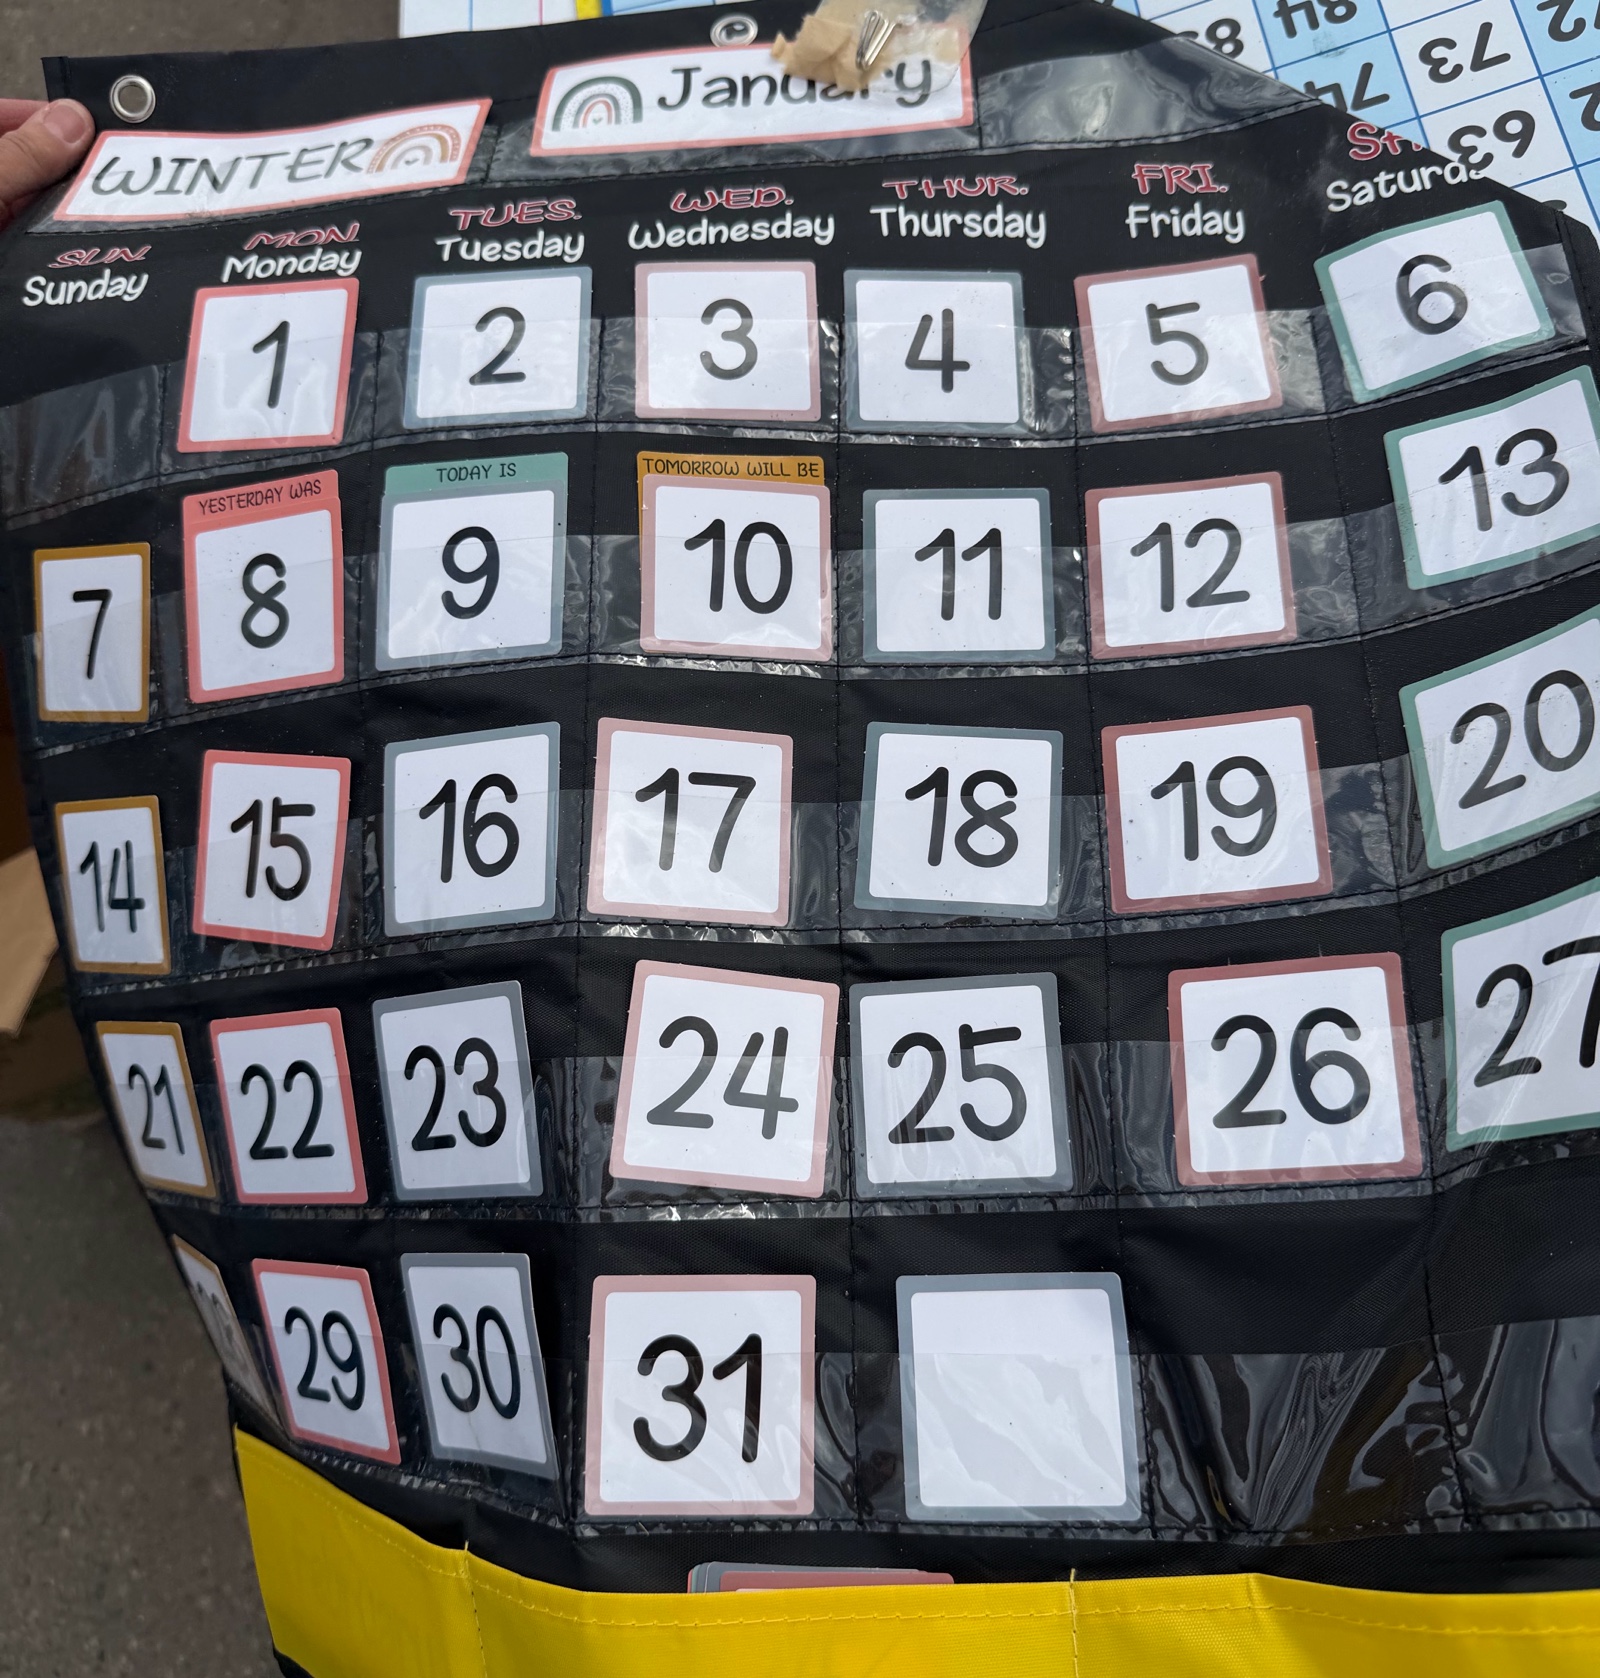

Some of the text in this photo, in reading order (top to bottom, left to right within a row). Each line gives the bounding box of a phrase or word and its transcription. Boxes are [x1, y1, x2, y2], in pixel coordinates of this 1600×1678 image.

[1177, 18, 1244, 59] 8
[1273, 0, 1357, 38] 84
[1418, 21, 1511, 84] 73
[91, 137, 374, 196] WINTER
[1132, 163, 1229, 195] FRI.
[1447, 110, 1536, 173] 63
[449, 198, 583, 231] TUES.
[627, 211, 835, 250] Wednesday
[670, 186, 794, 213] WED.
[869, 201, 1047, 249] Thursday
[882, 175, 1030, 199] THUR.
[1125, 201, 1245, 244] Friday
[23, 269, 149, 307] Sunday
[220, 248, 362, 284] Monday
[435, 229, 585, 264] Tuesday
[1396, 255, 1468, 335] 6
[253, 321, 289, 408] 1
[469, 307, 525, 385] 2
[700, 299, 757, 380] 3
[905, 309, 970, 393] 4
[1146, 302, 1208, 385] 5
[199, 479, 322, 516] YESTERDAY WAS
[437, 462, 517, 483] TODAY IS
[643, 458, 820, 478] TOMORROW WILL BE
[1436, 428, 1570, 532] 13
[241, 553, 289, 649] 8
[441, 526, 500, 619] 9
[684, 519, 792, 614] 10
[915, 528, 1002, 620] 11
[1131, 518, 1250, 612] 12
[72, 589, 112, 679] 7
[1450, 669, 1596, 809] 20
[230, 797, 315, 901] 15
[419, 774, 519, 883] 16
[635, 768, 756, 872] 17
[905, 767, 1018, 868] 18
[1151, 756, 1277, 861] 19
[79, 840, 145, 933] 14
[1474, 935, 1600, 1087] 27
[128, 1063, 186, 1155] 21
[240, 1060, 335, 1160] 22
[404, 1038, 506, 1151] 23
[647, 1016, 798, 1139] 24
[888, 1024, 1027, 1144] 25
[1211, 1007, 1370, 1128] 26
[284, 1306, 366, 1411] 29
[433, 1303, 521, 1420] 30
[633, 1334, 762, 1463] 31
